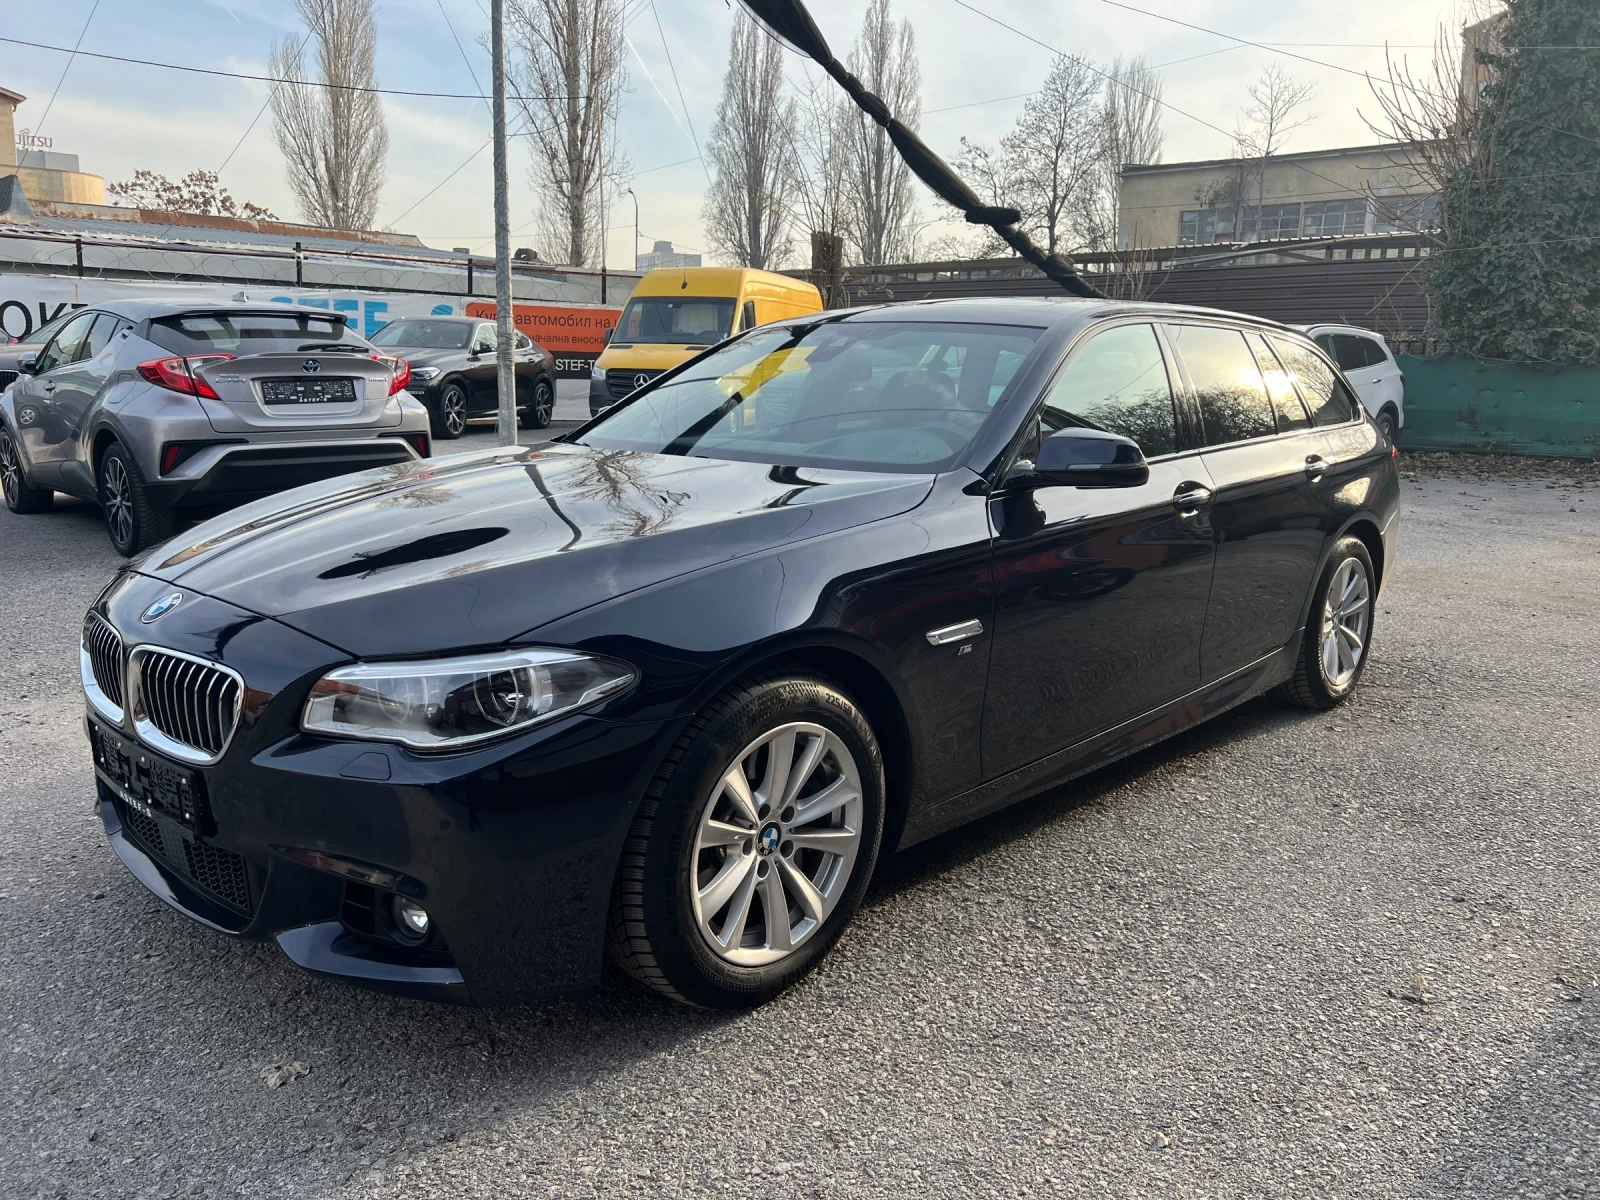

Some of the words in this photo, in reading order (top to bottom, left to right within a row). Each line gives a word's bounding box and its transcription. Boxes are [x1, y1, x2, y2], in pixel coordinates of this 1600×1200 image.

[515, 314, 591, 328] автомобил
[595, 318, 611, 329] на
[571, 336, 605, 345] вноска
[120, 790, 152, 818] ASTEF-S
